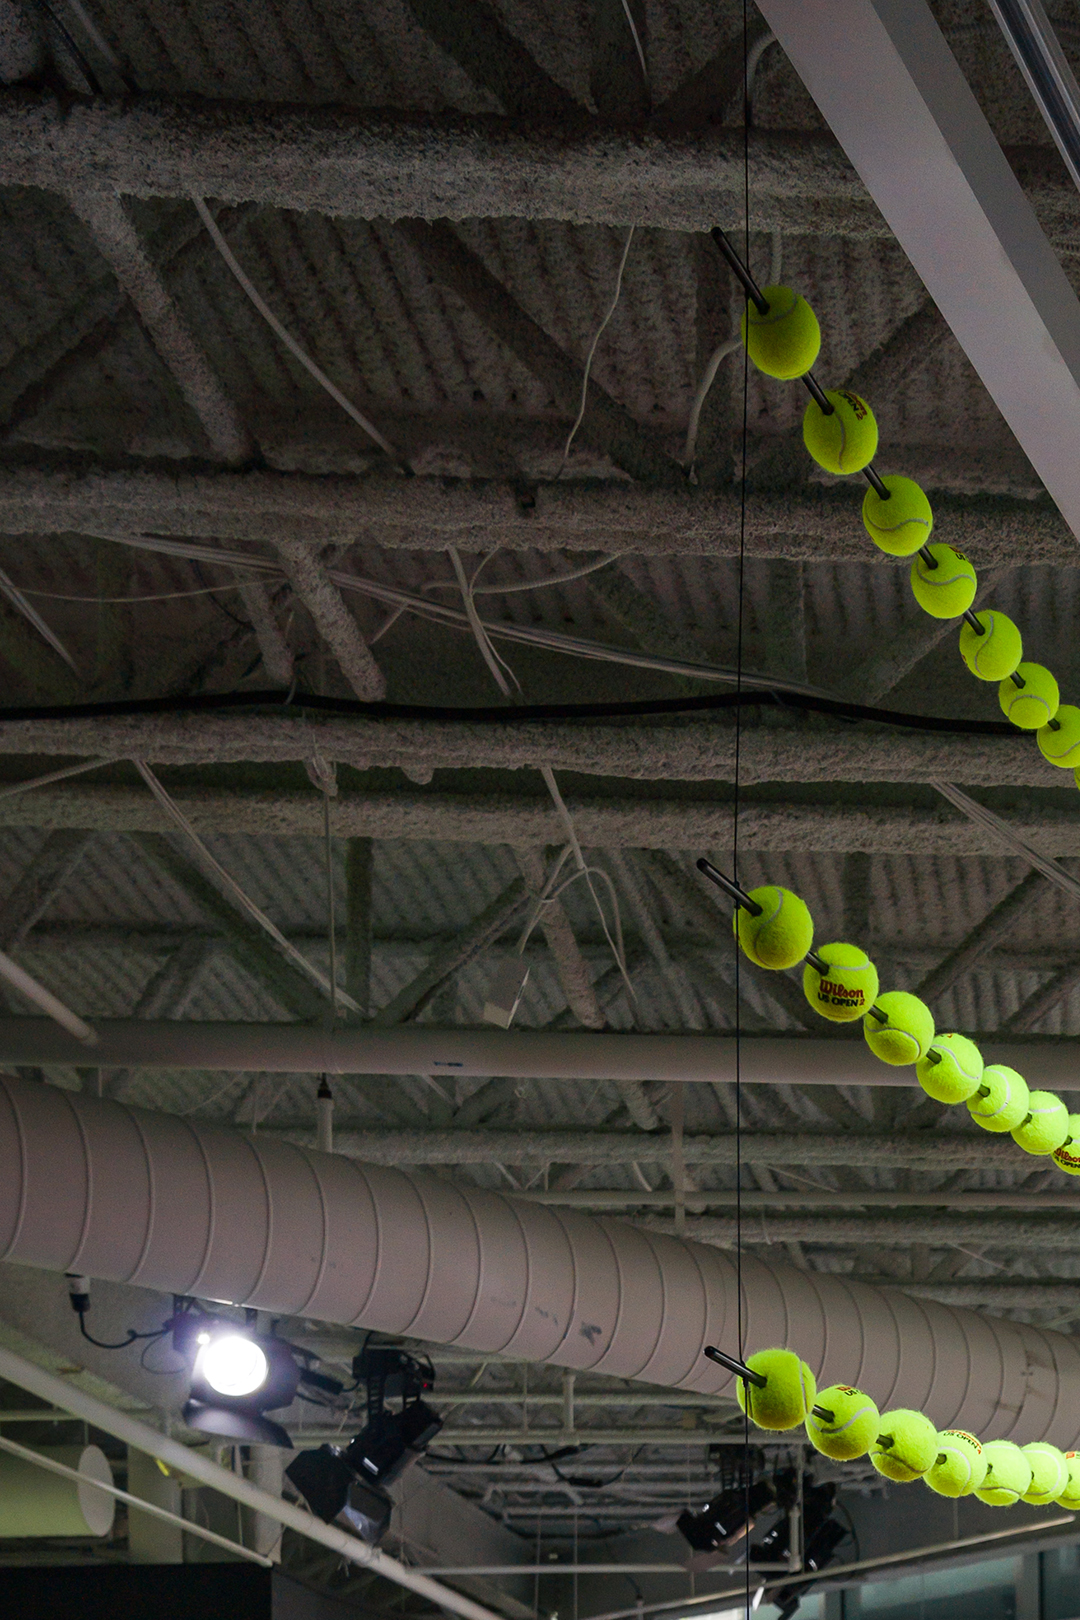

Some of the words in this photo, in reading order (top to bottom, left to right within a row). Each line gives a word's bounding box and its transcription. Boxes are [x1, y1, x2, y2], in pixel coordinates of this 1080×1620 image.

[820, 979, 864, 998] Wilson
[818, 992, 830, 1003] US
[831, 997, 859, 1007] OPEN
[859, 998, 866, 1006] 2
